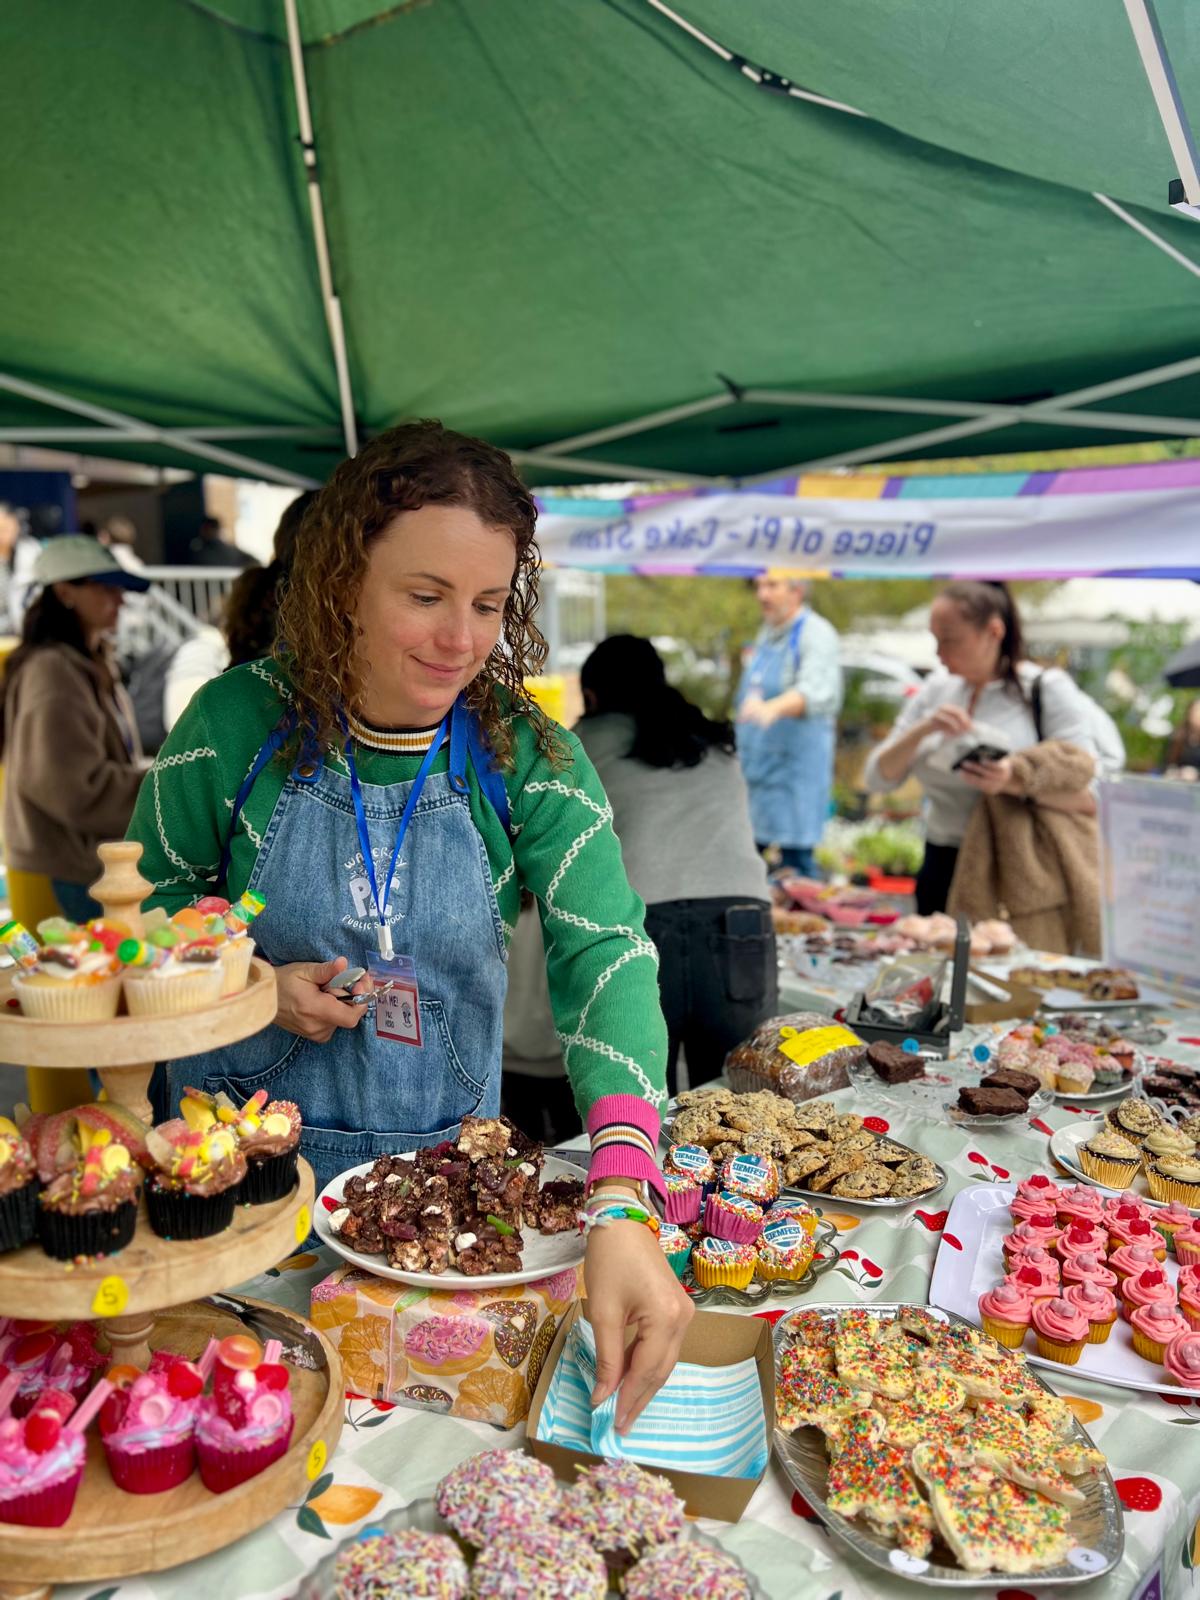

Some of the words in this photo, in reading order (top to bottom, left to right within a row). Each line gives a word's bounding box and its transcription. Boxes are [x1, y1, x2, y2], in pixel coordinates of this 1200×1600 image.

[342, 914, 372, 930] PUBLIC
[373, 912, 406, 928] SHOOL
[101, 1283, 118, 1306] 5
[313, 1447, 321, 1469] 5
[1080, 1553, 1094, 1562] 2
